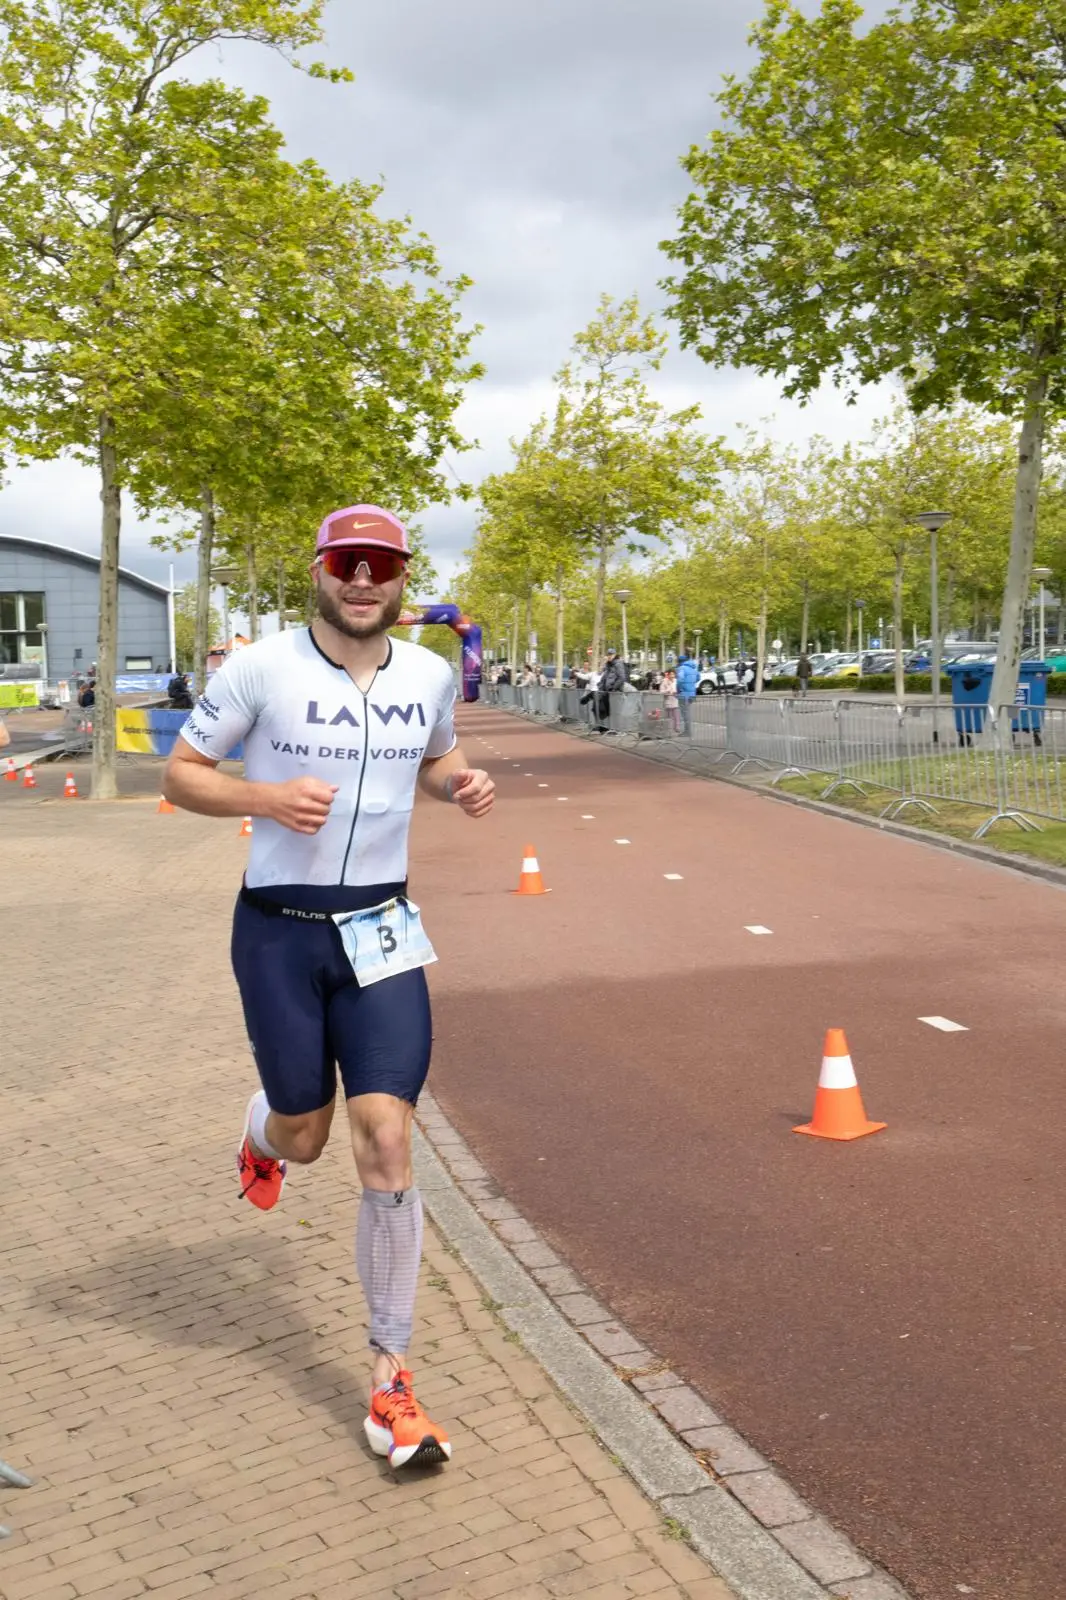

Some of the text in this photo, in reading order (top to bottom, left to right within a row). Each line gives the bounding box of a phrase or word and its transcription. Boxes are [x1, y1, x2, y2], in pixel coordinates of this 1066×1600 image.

[306, 700, 426, 727] LAWI
[270, 739, 424, 760] VAN DER VORST
[376, 925, 397, 953] 3
